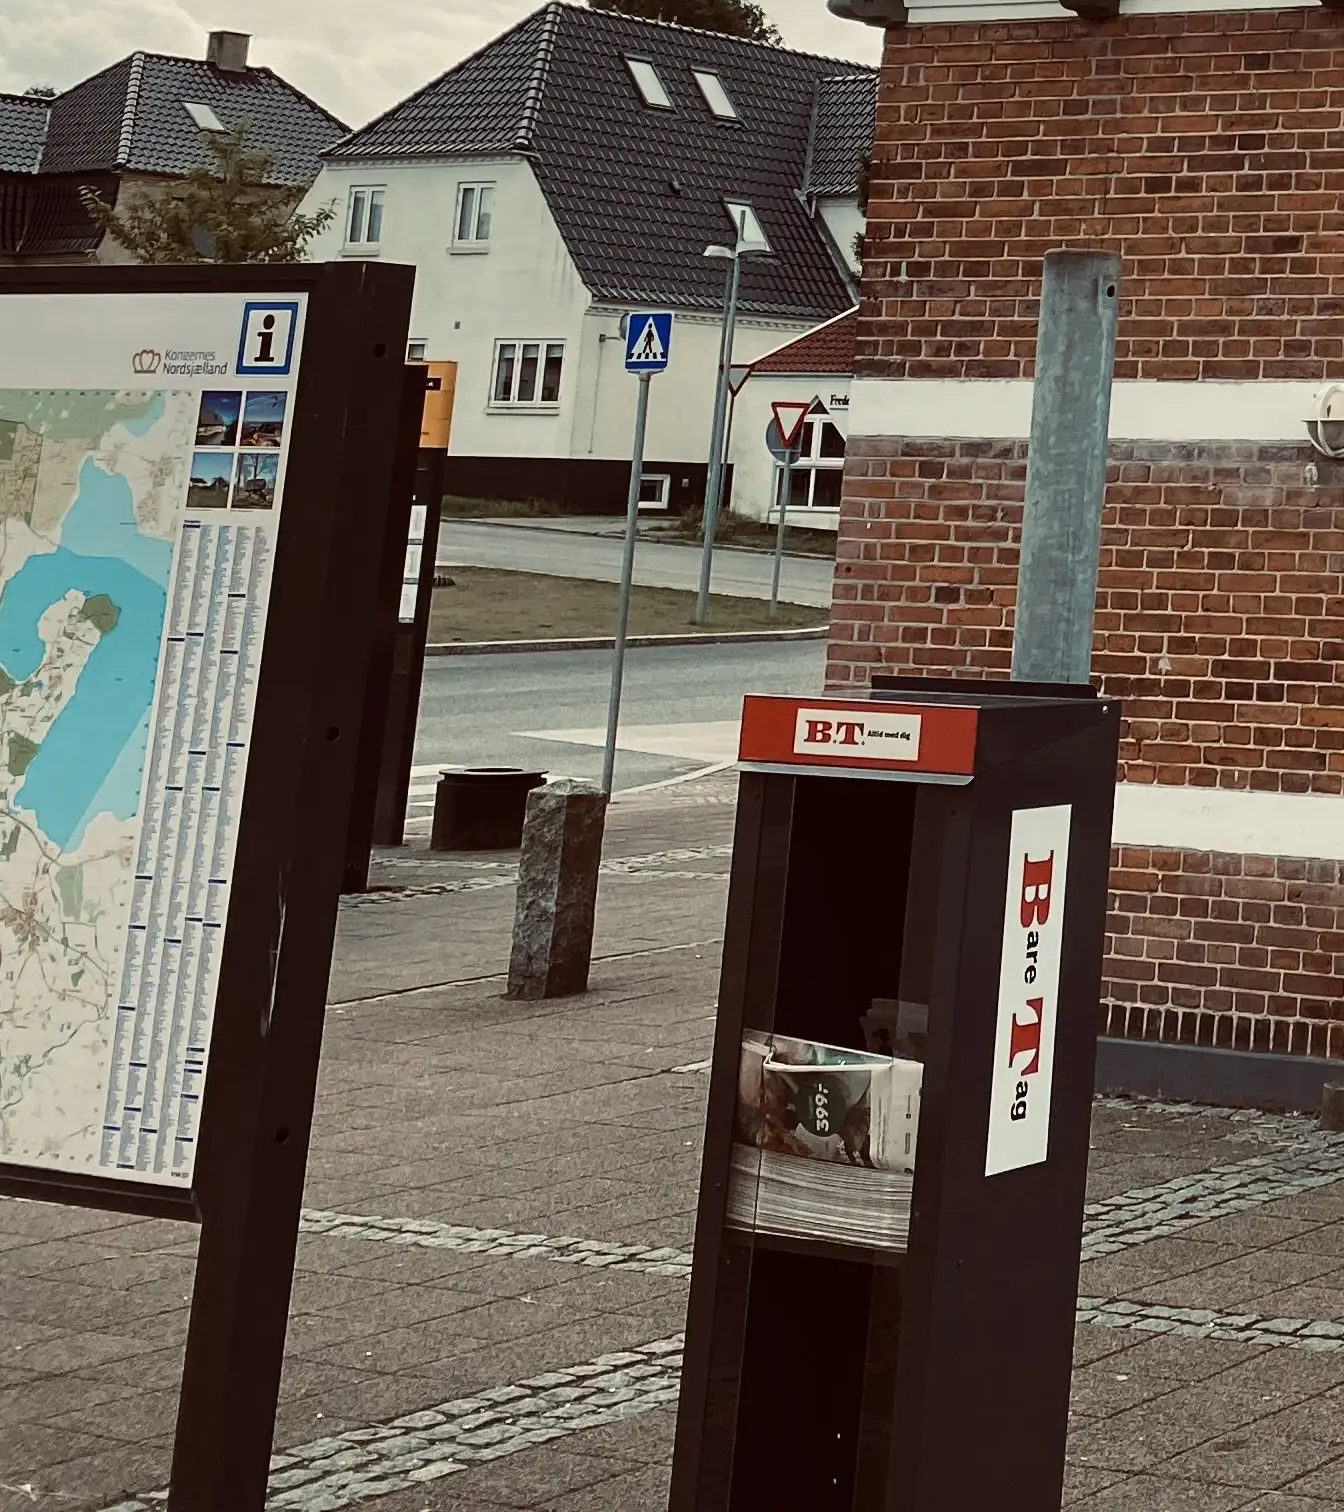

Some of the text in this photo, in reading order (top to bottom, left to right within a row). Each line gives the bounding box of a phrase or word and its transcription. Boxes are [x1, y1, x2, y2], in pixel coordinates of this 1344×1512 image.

[164, 349, 216, 361] Kongernes
[162, 362, 228, 377] Nordsjælland
[804, 719, 865, 746] B.T.
[1009, 849, 1055, 1122] Bare Tag
